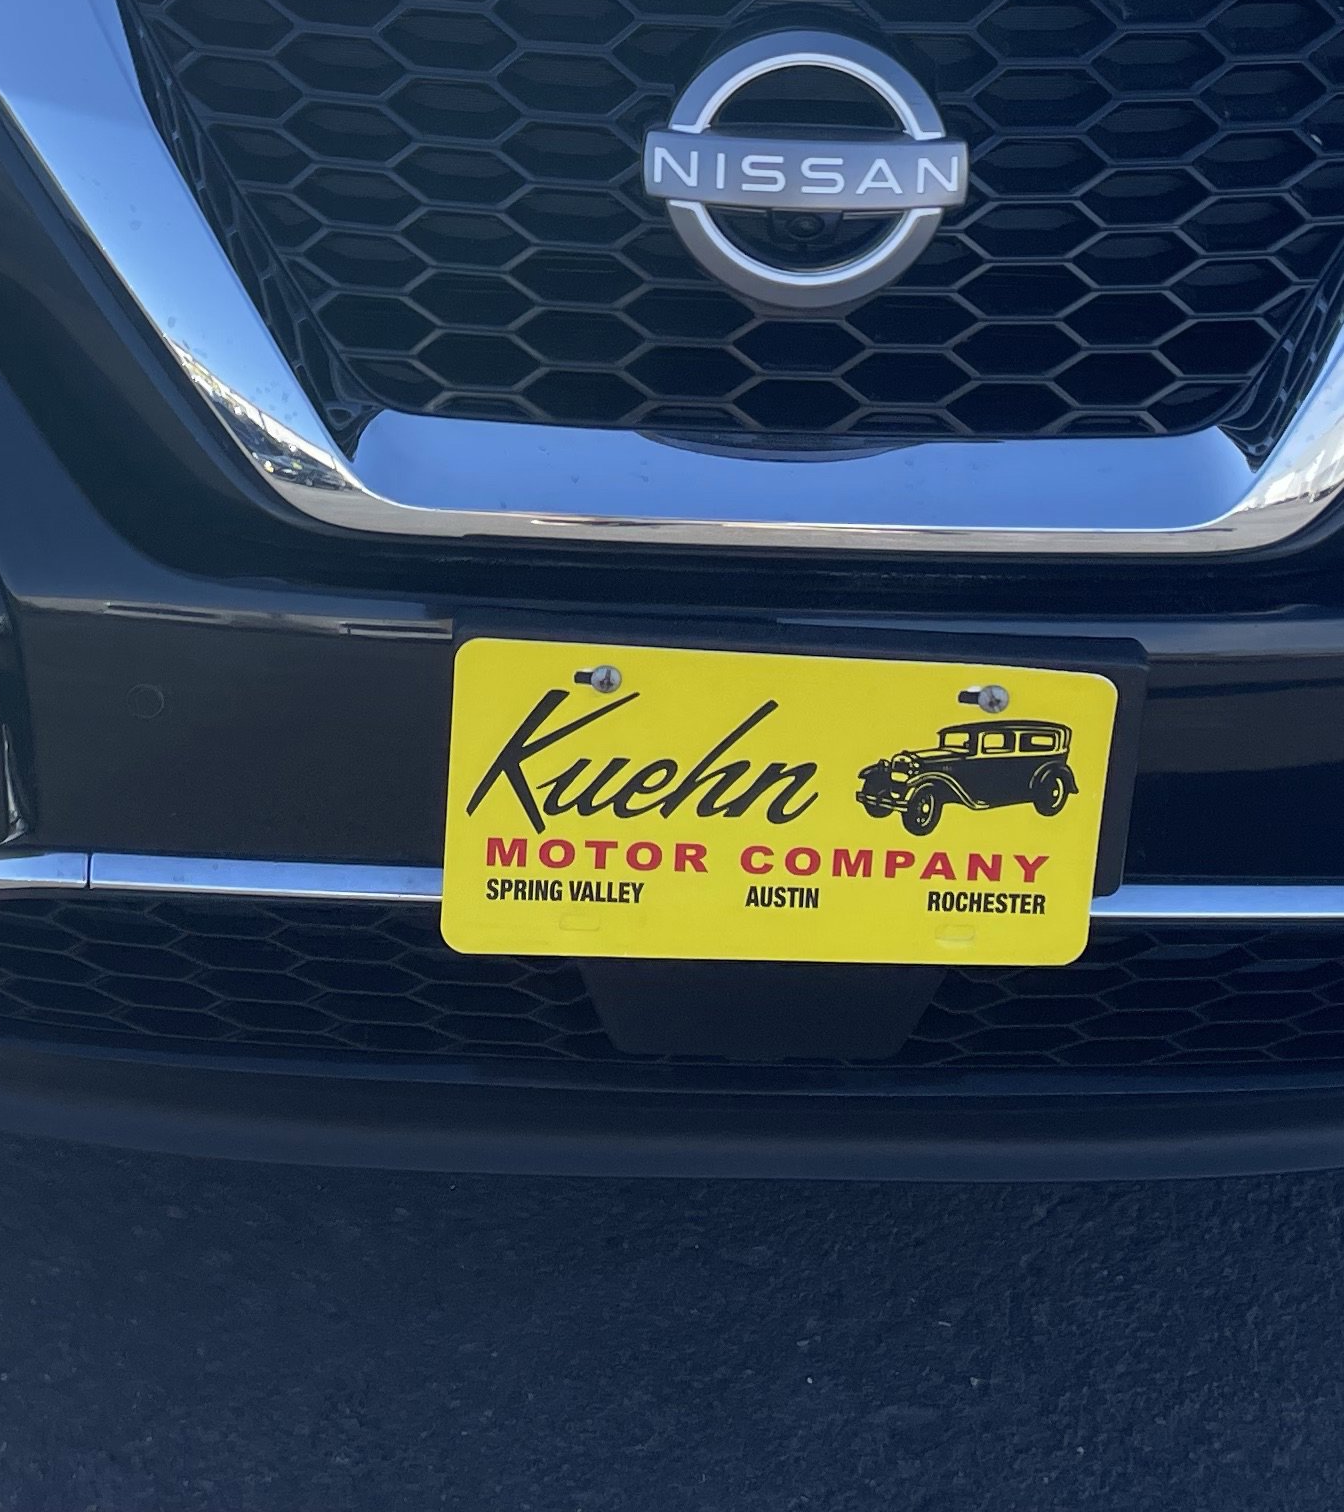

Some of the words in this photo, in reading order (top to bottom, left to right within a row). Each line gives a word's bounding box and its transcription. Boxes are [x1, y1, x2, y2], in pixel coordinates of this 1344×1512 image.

[653, 146, 959, 195] NISSAN
[466, 688, 818, 834] Kuehn
[485, 836, 708, 875] MOTOR
[739, 844, 1051, 884] COMPANY
[485, 877, 563, 903] SPRING
[568, 880, 645, 904] VALLEY
[745, 884, 820, 908] AUSTIN
[926, 889, 1046, 915] ROCHESTER
